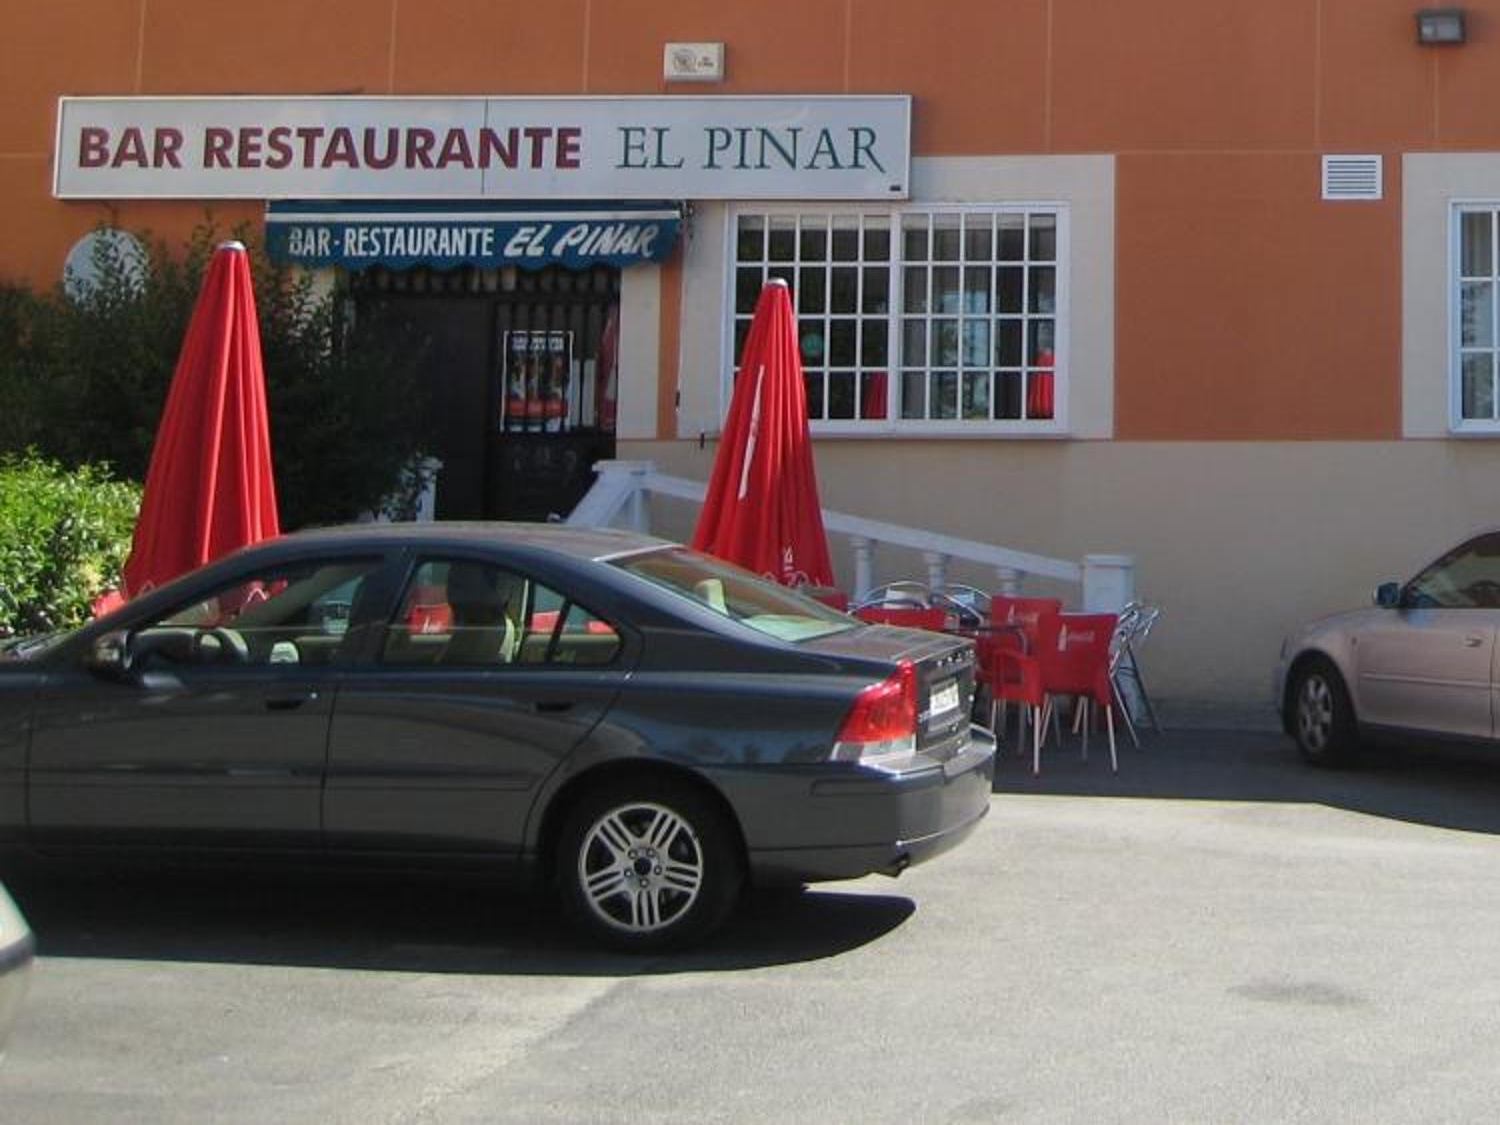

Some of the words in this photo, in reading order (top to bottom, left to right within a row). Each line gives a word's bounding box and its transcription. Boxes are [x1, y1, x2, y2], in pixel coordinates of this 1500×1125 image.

[78, 127, 184, 169] BAR
[202, 127, 582, 170] RESTAURANTE
[616, 127, 685, 170] EL
[701, 127, 886, 173] PINAR
[503, 224, 552, 257] EL
[551, 223, 660, 258] PINAR
